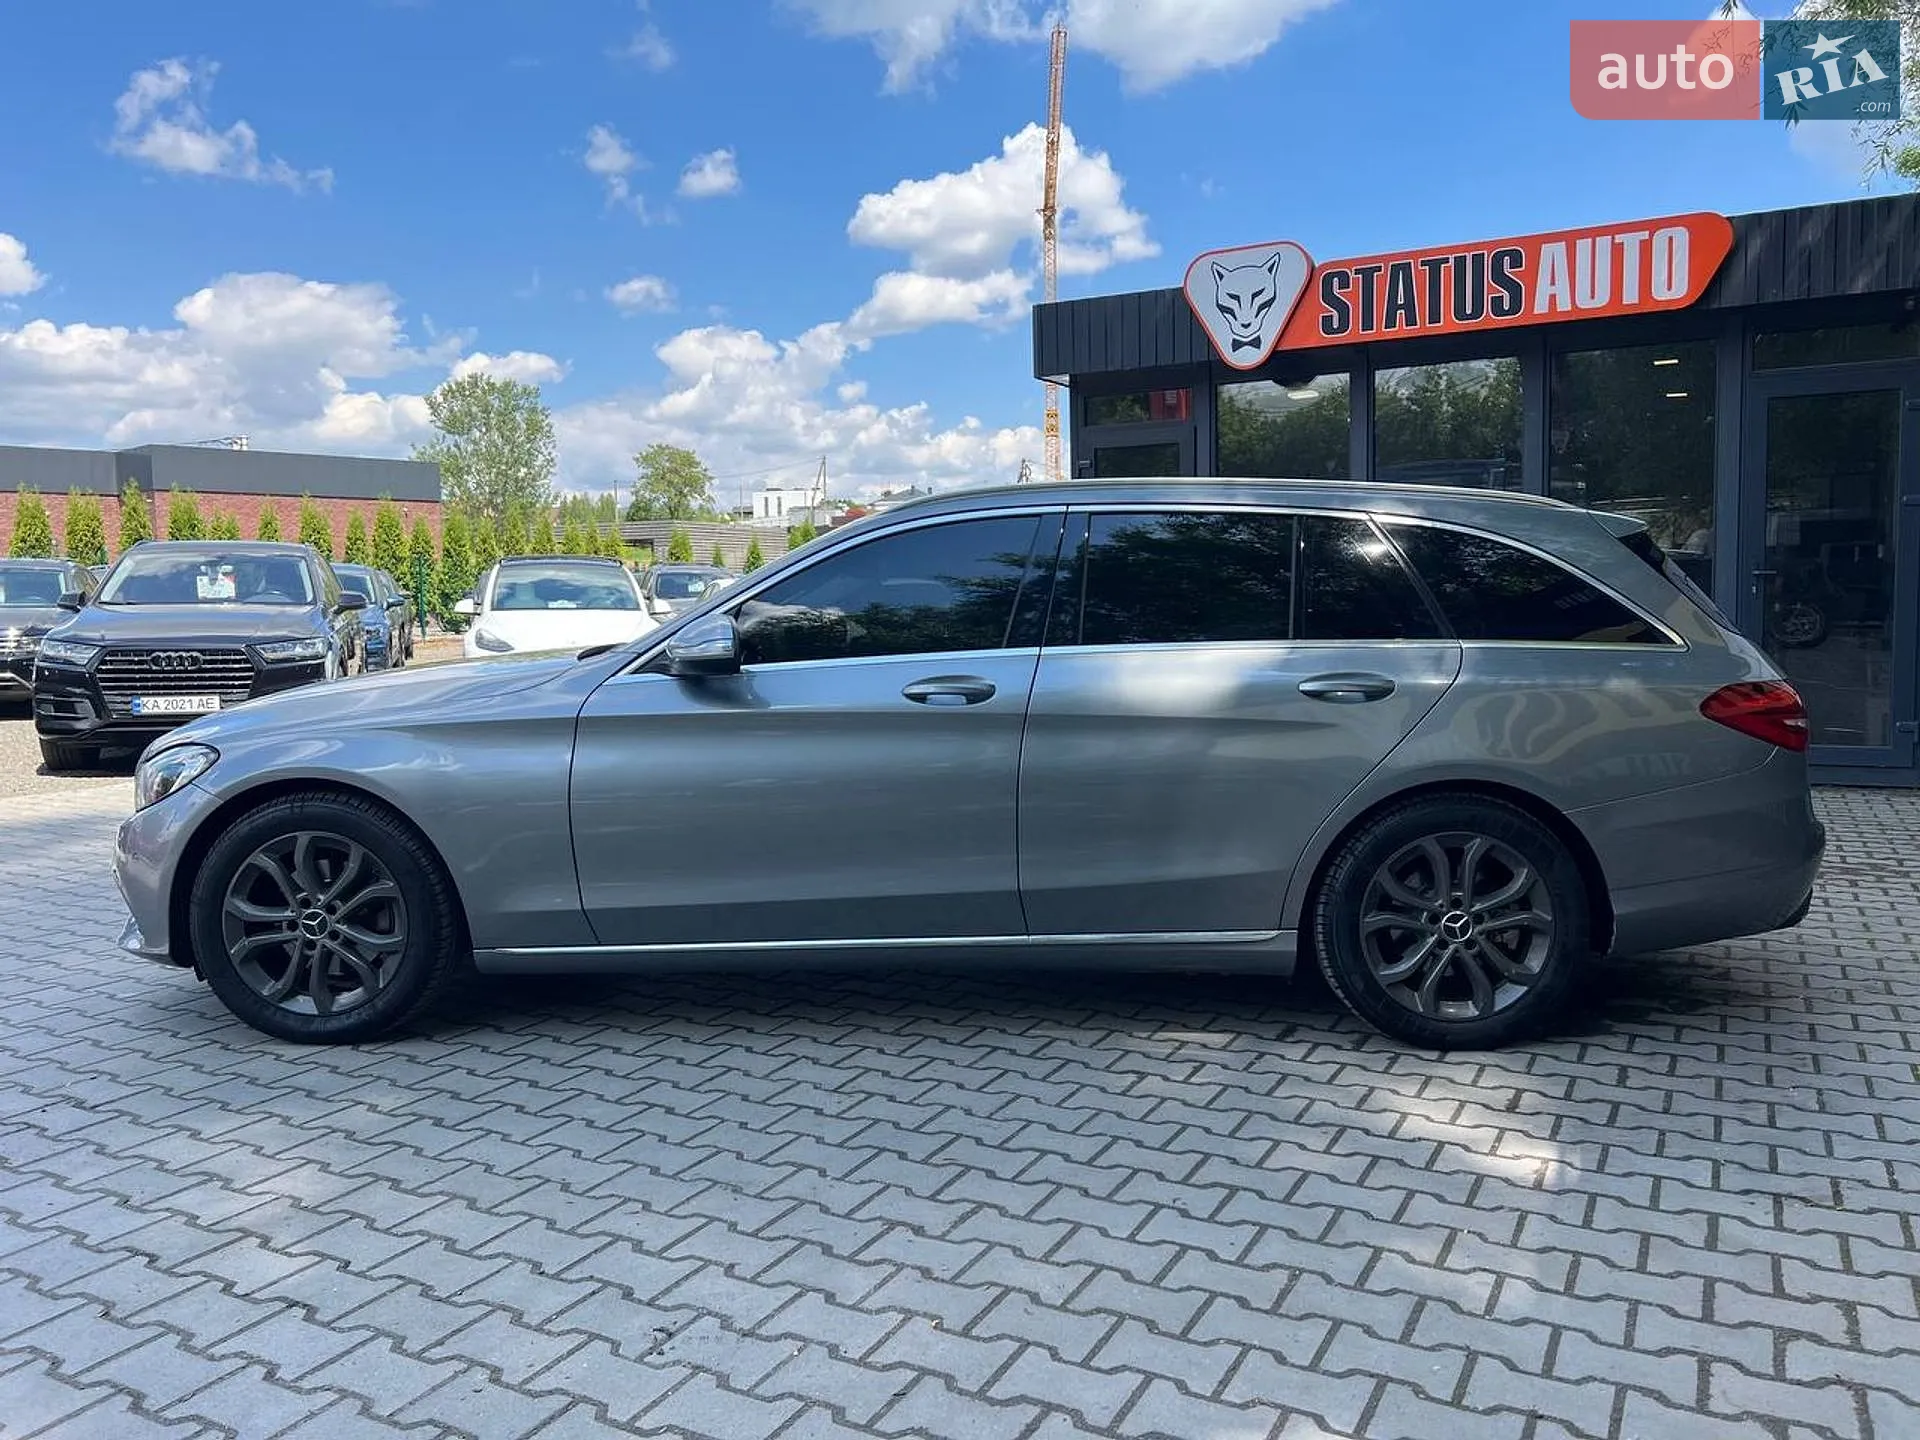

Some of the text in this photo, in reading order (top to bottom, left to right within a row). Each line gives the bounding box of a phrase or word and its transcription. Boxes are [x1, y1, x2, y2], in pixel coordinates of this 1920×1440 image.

[142, 697, 216, 711] KA 2021 AE
